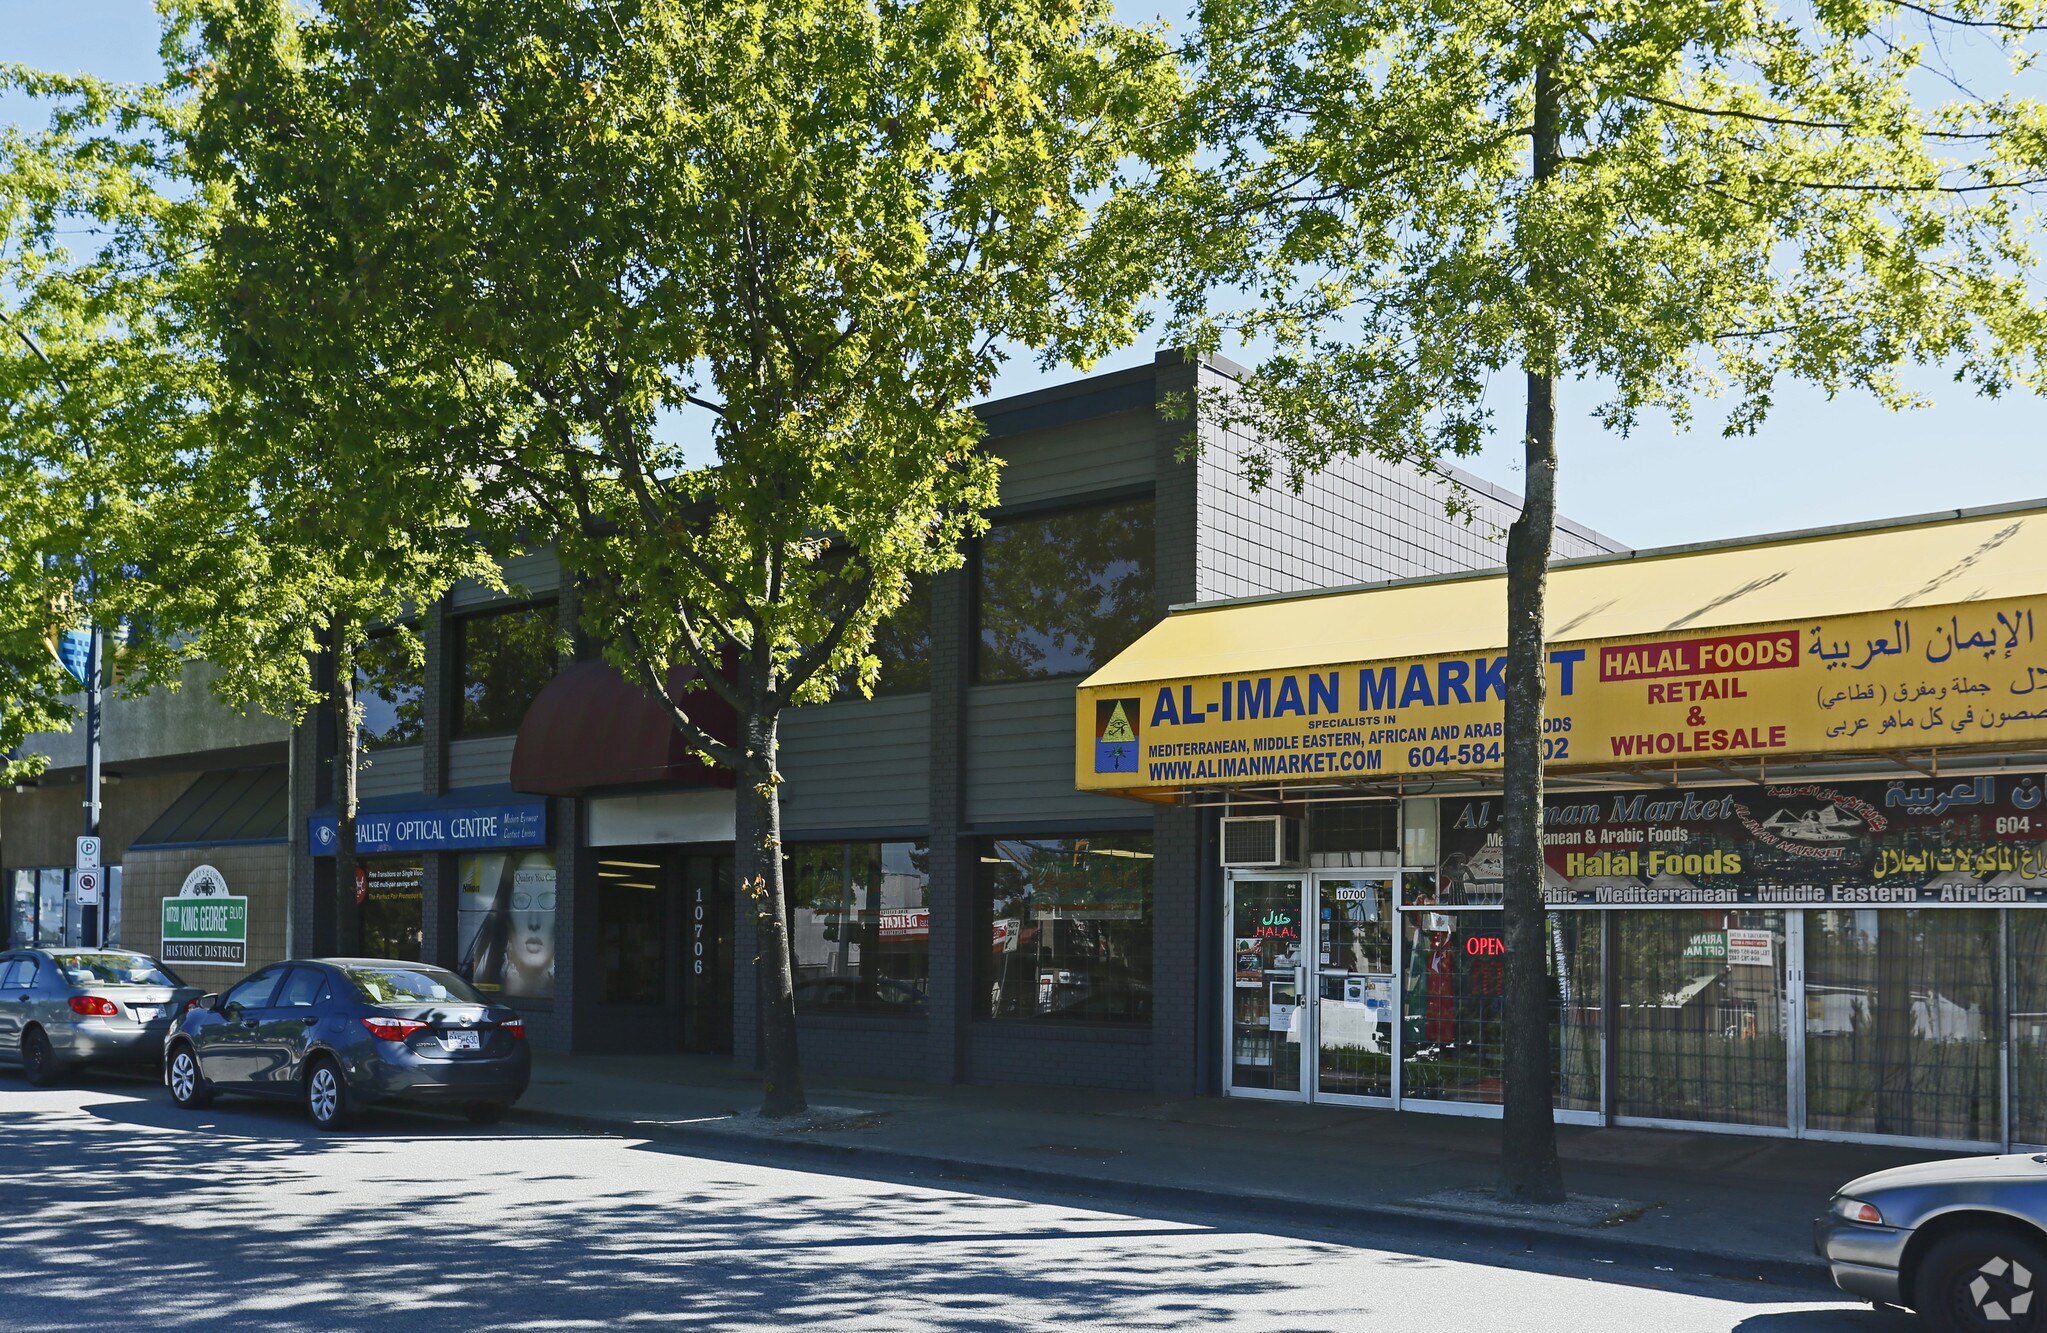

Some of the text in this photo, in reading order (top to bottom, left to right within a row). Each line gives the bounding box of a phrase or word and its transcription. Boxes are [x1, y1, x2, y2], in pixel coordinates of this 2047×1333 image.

[1808, 608, 2034, 671] الإيمان العربية
[1605, 638, 1792, 677] HALAL FOODS
[1150, 649, 1585, 727] AL-IMAN MARKT
[1647, 677, 1747, 705] RETAIL
[1308, 714, 1396, 730] SPECIALISTS IN
[1686, 705, 1707, 727] &
[1920, 706, 1945, 730] كل
[1950, 704, 1974, 734] في
[1148, 716, 1572, 758] MEDITERRANEAN, MIDDLE EASTERN, AFRICAN AND ARAB ODS
[1610, 725, 1786, 757] WHOLESALE
[1148, 749, 1382, 781] WWW.ALIMANMARKET.COM
[1885, 776, 1995, 817] العربية
[1453, 800, 1491, 830] Al
[1607, 791, 1736, 824] Market
[396, 820, 445, 841] OPTICAL
[450, 816, 497, 839] CENTRE
[1487, 826, 1689, 848] Meanean & Arabic Foods
[1733, 802, 1846, 859] AL-IMAN MARKET
[1995, 816, 2030, 834] 604
[1566, 849, 1742, 877] Halal Foods
[515, 872, 535, 885] Quality
[1337, 889, 1367, 900] 10700
[1544, 887, 1578, 903] abic
[1595, 886, 1738, 903] Mediterranean
[1757, 884, 1826, 903] Middle
[1831, 884, 1918, 903] Eastern
[1939, 883, 2026, 903] African
[181, 906, 199, 932] KING
[199, 905, 229, 932] GEORGE
[229, 906, 244, 920] BLVD
[694, 887, 704, 975] 10706
[1256, 926, 1296, 936] HALAL
[1262, 910, 1291, 925] حلال
[166, 944, 241, 959] HISTORIC DISTRICT
[1465, 937, 1505, 956] OPEN
